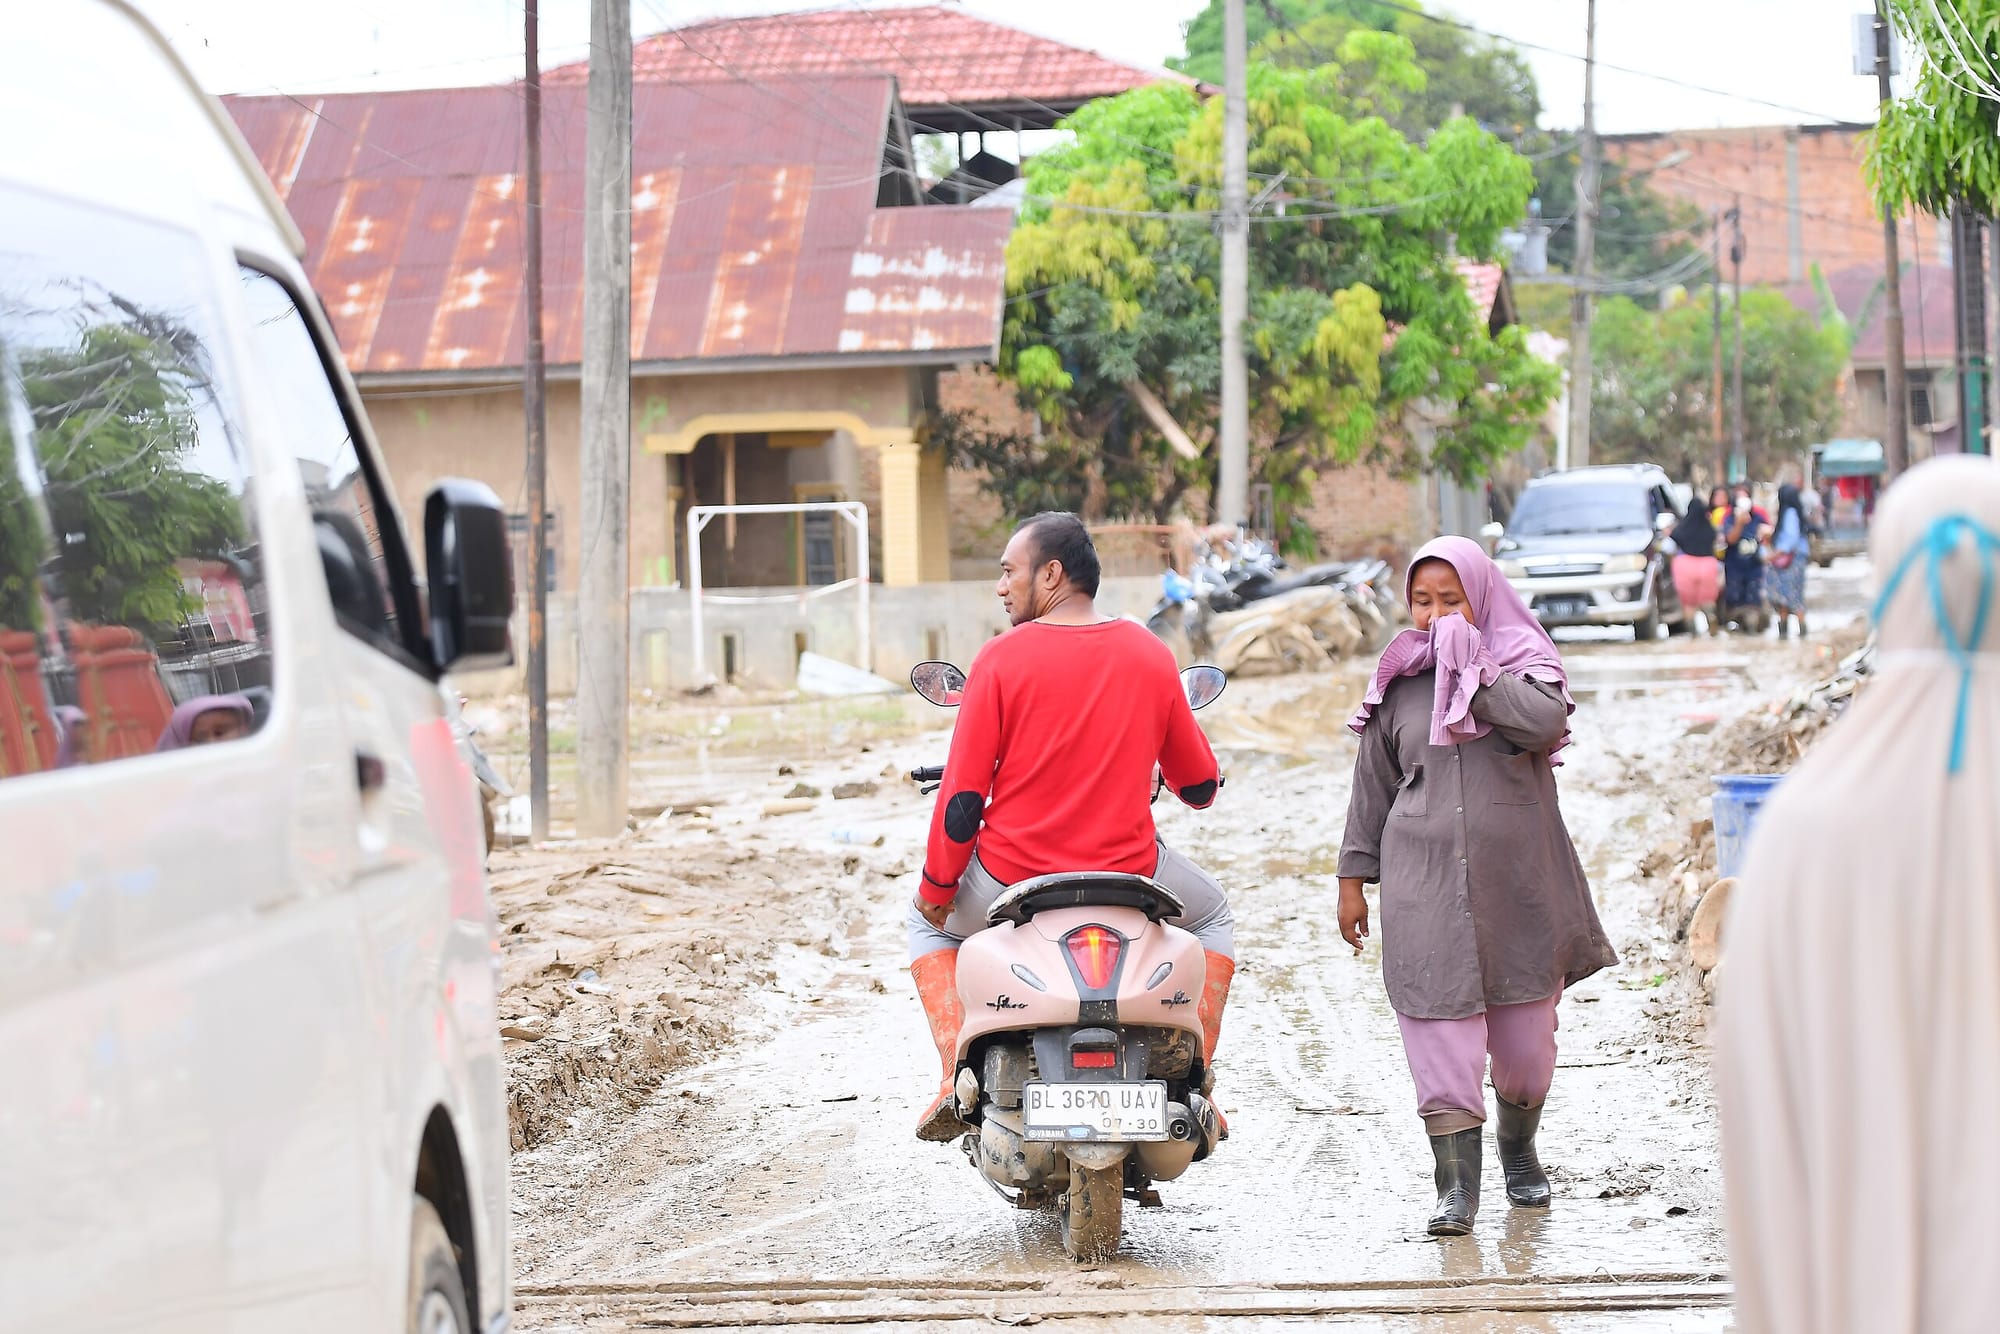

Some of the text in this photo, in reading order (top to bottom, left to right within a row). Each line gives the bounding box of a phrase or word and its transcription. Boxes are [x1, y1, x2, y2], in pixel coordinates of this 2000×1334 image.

[1031, 1090, 1158, 1109] BL 3670 UAV
